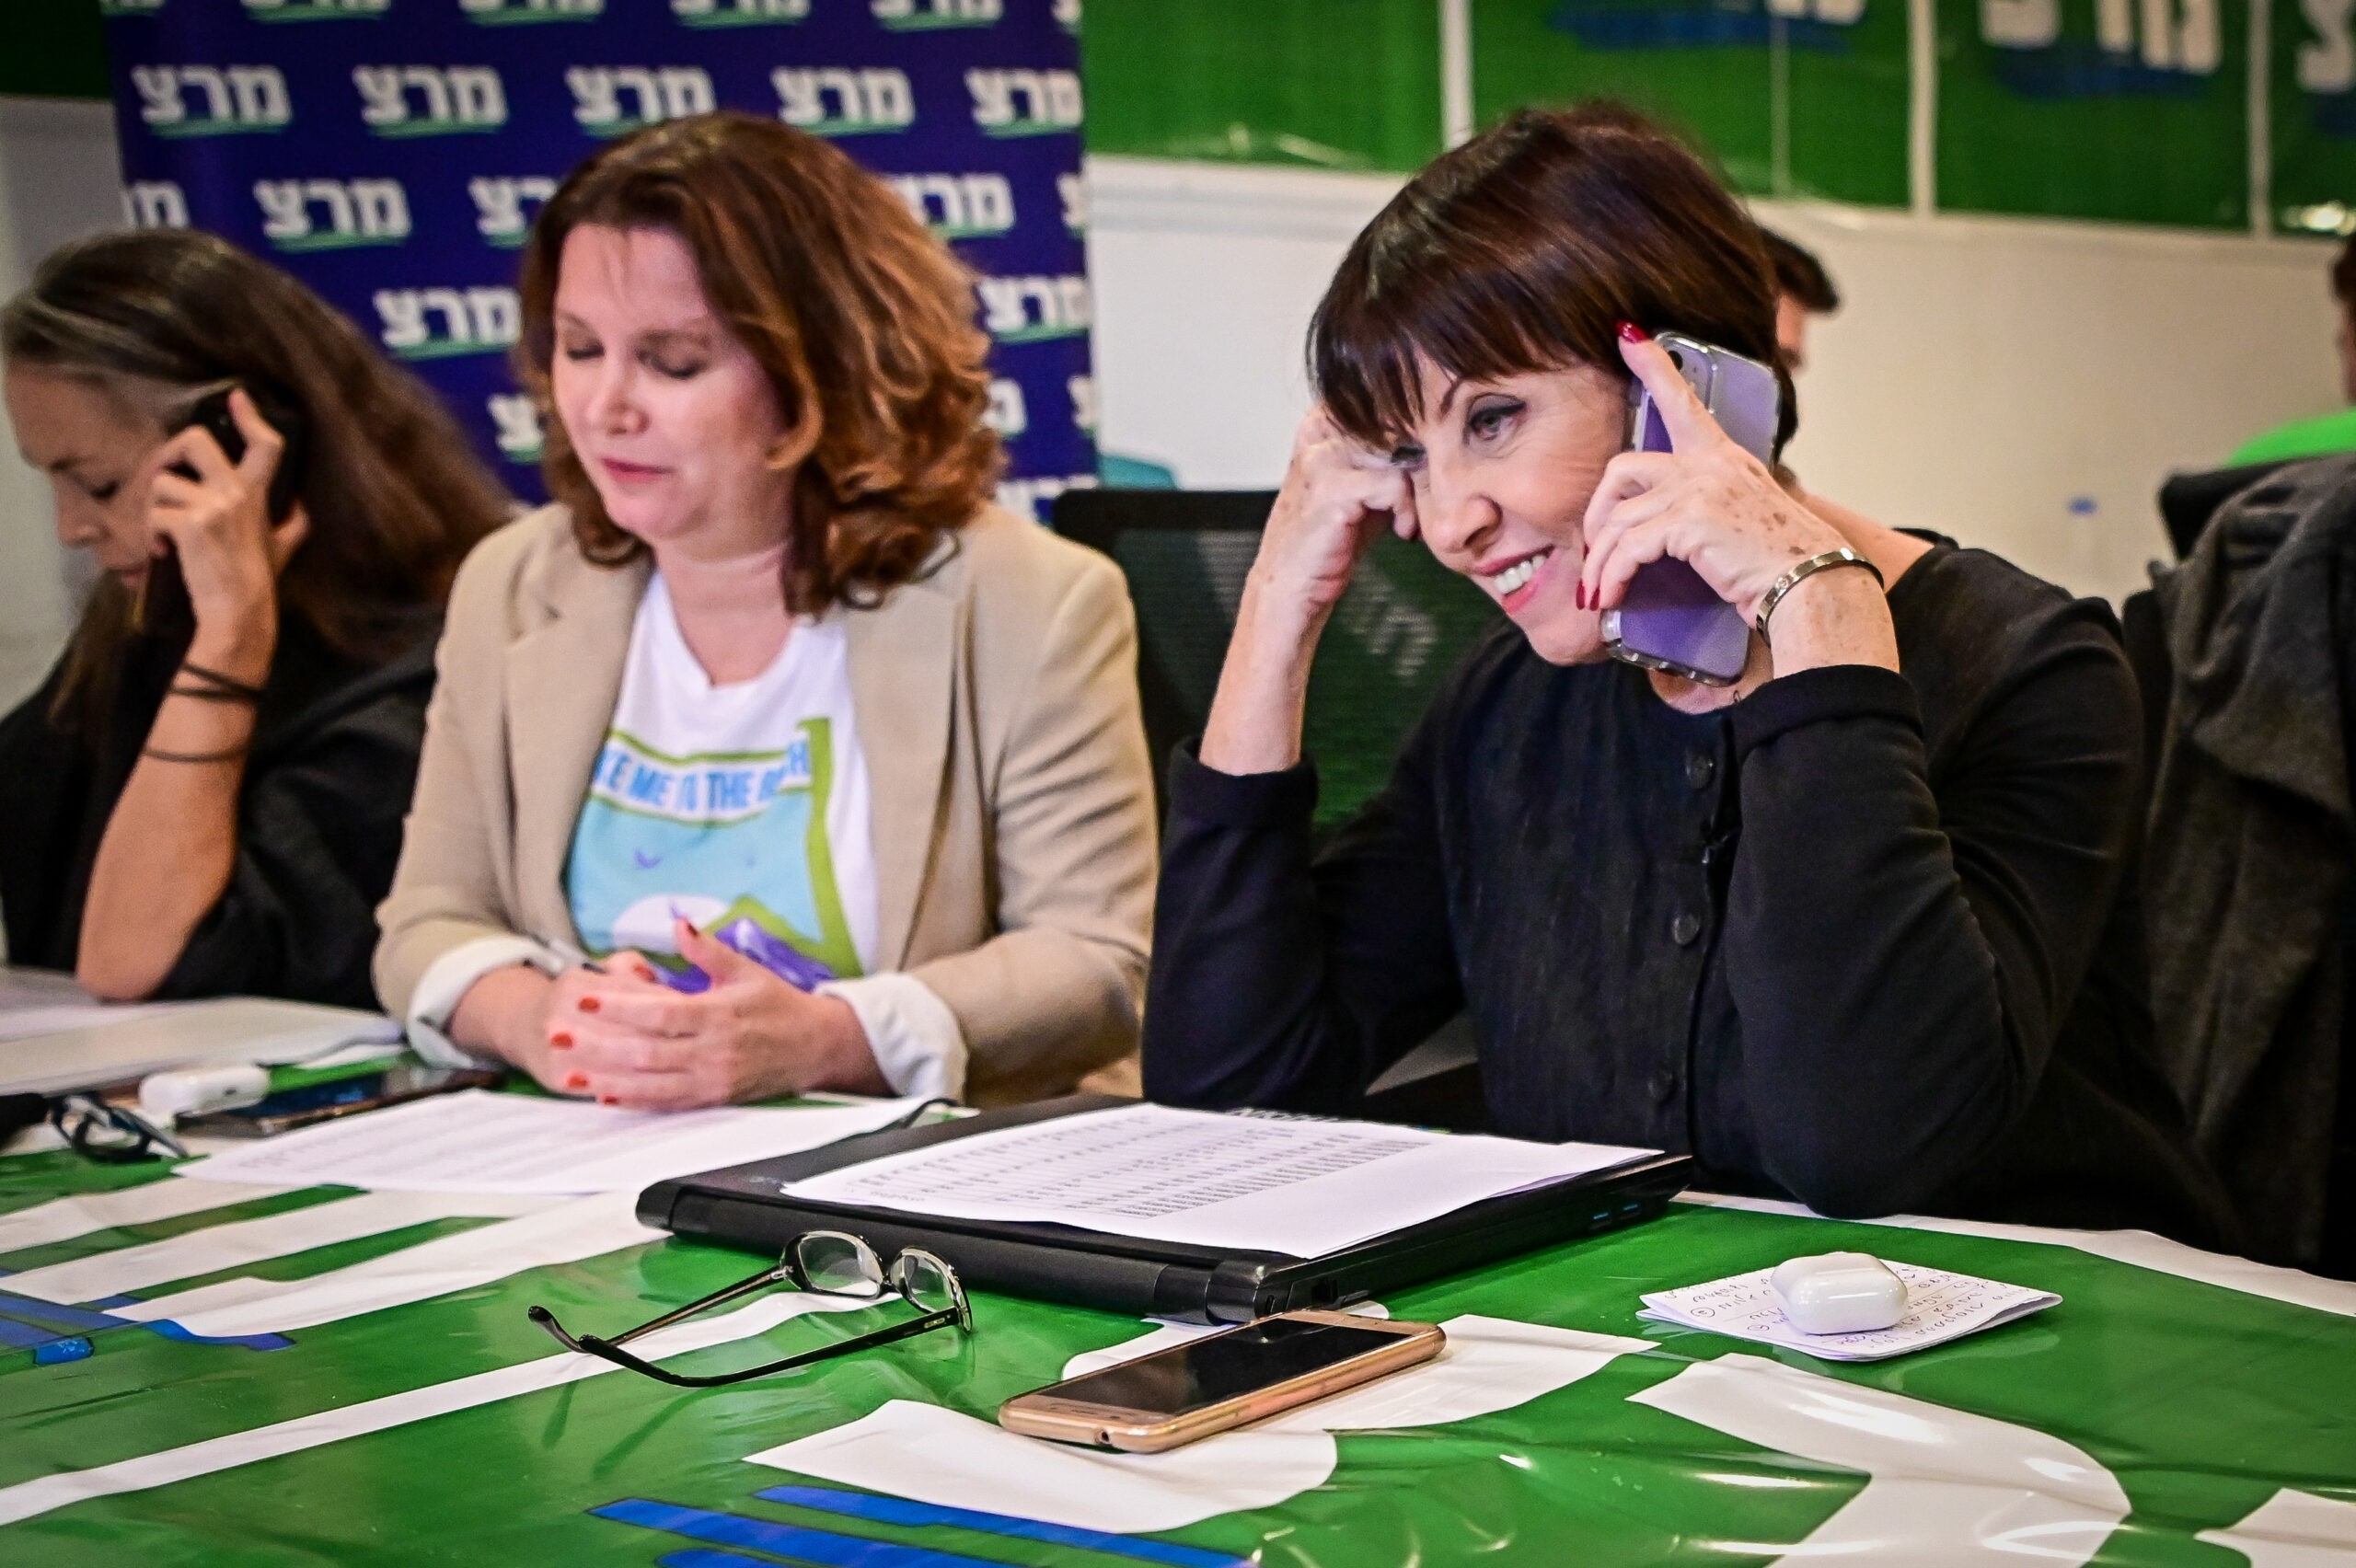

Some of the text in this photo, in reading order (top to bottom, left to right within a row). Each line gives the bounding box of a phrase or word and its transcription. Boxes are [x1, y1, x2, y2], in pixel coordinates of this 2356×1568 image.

[132, 65, 293, 125] מרצ
[352, 65, 507, 125] מרצ
[565, 66, 715, 124] מרצ
[771, 67, 915, 126] מרצ
[254, 179, 410, 239] מרצ
[374, 288, 522, 347] מרצ
